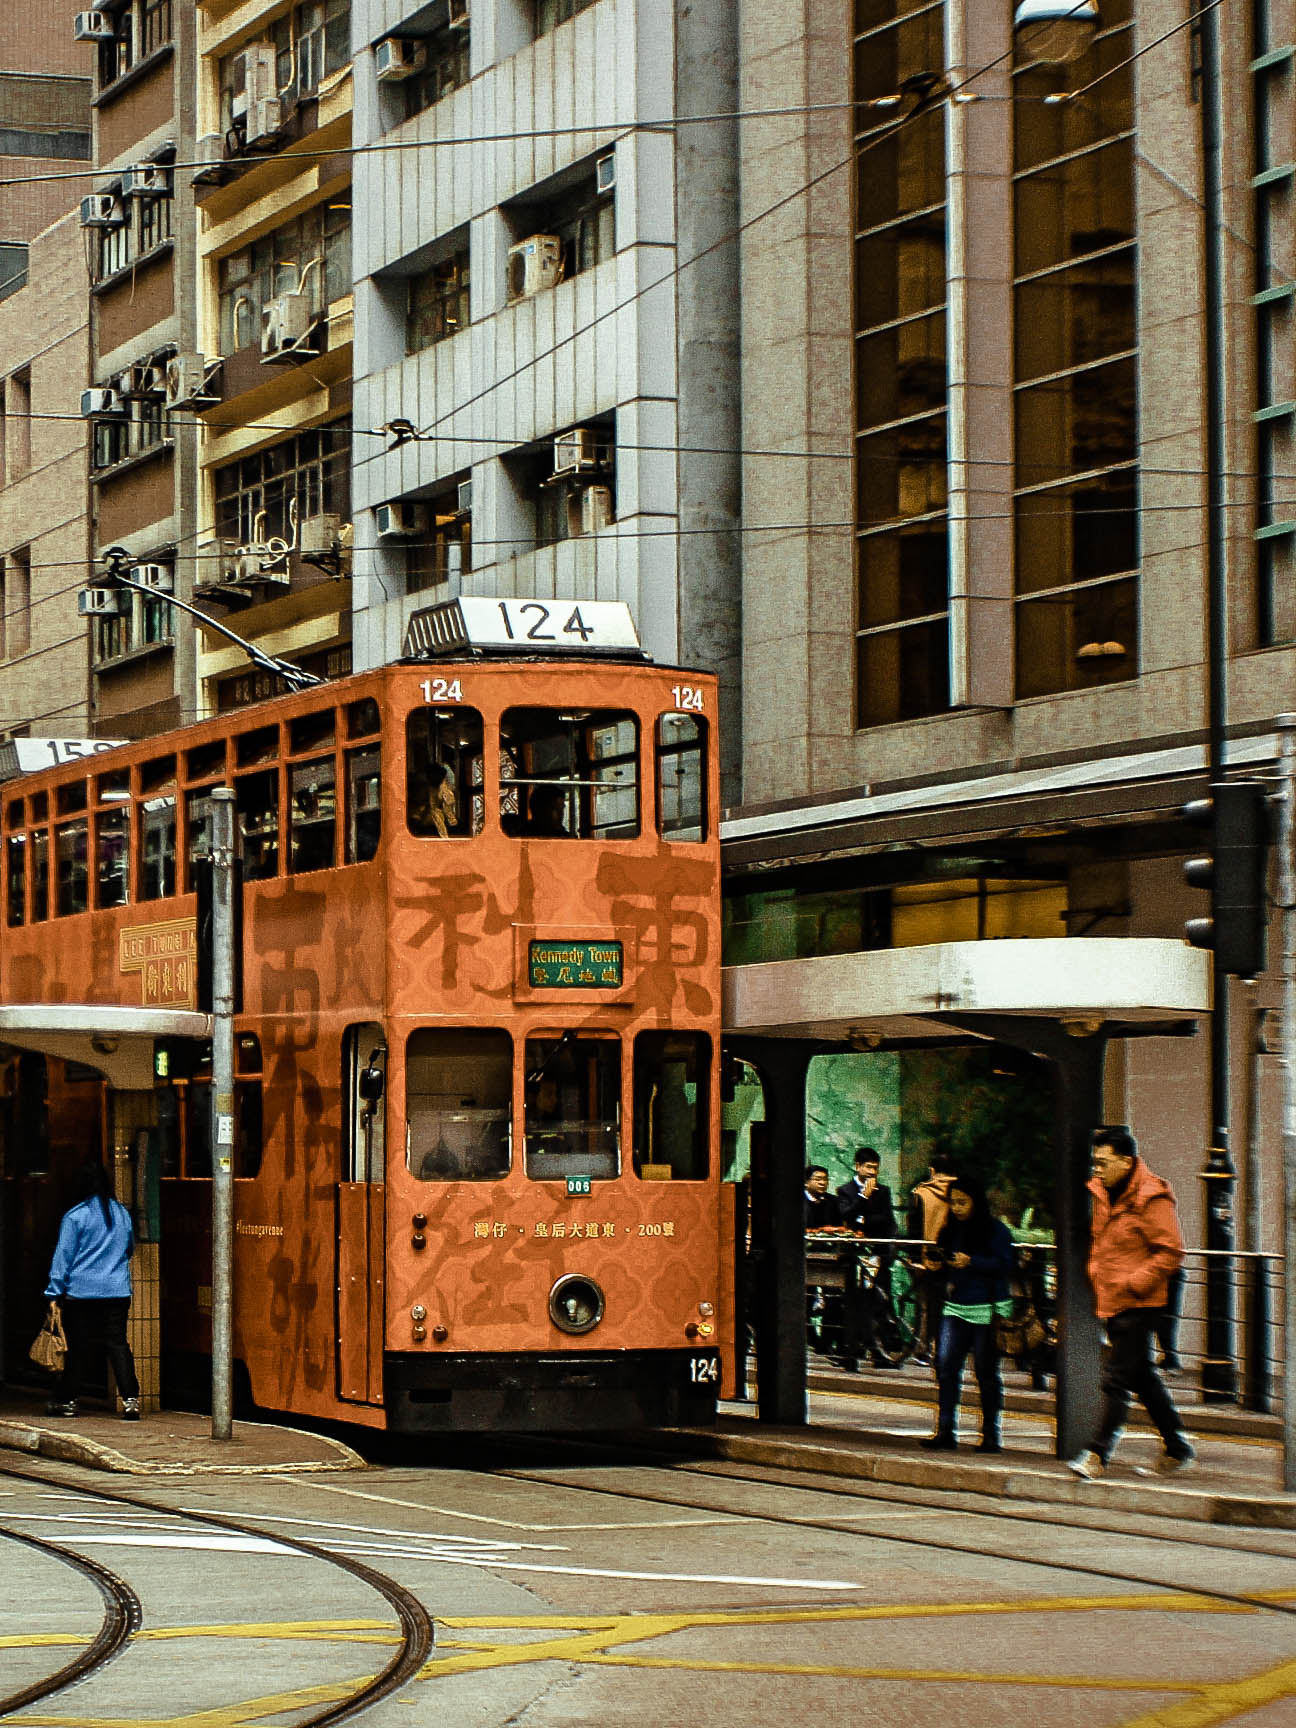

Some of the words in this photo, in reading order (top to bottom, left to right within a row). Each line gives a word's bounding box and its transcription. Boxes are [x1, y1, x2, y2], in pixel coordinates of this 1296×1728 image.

[498, 601, 594, 642] 124
[419, 678, 463, 703] 124
[672, 686, 704, 711] 124
[531, 946, 584, 966] Kennedy
[588, 946, 620, 963] Town
[567, 1180, 591, 1193] 006
[689, 1358, 718, 1383] 124
